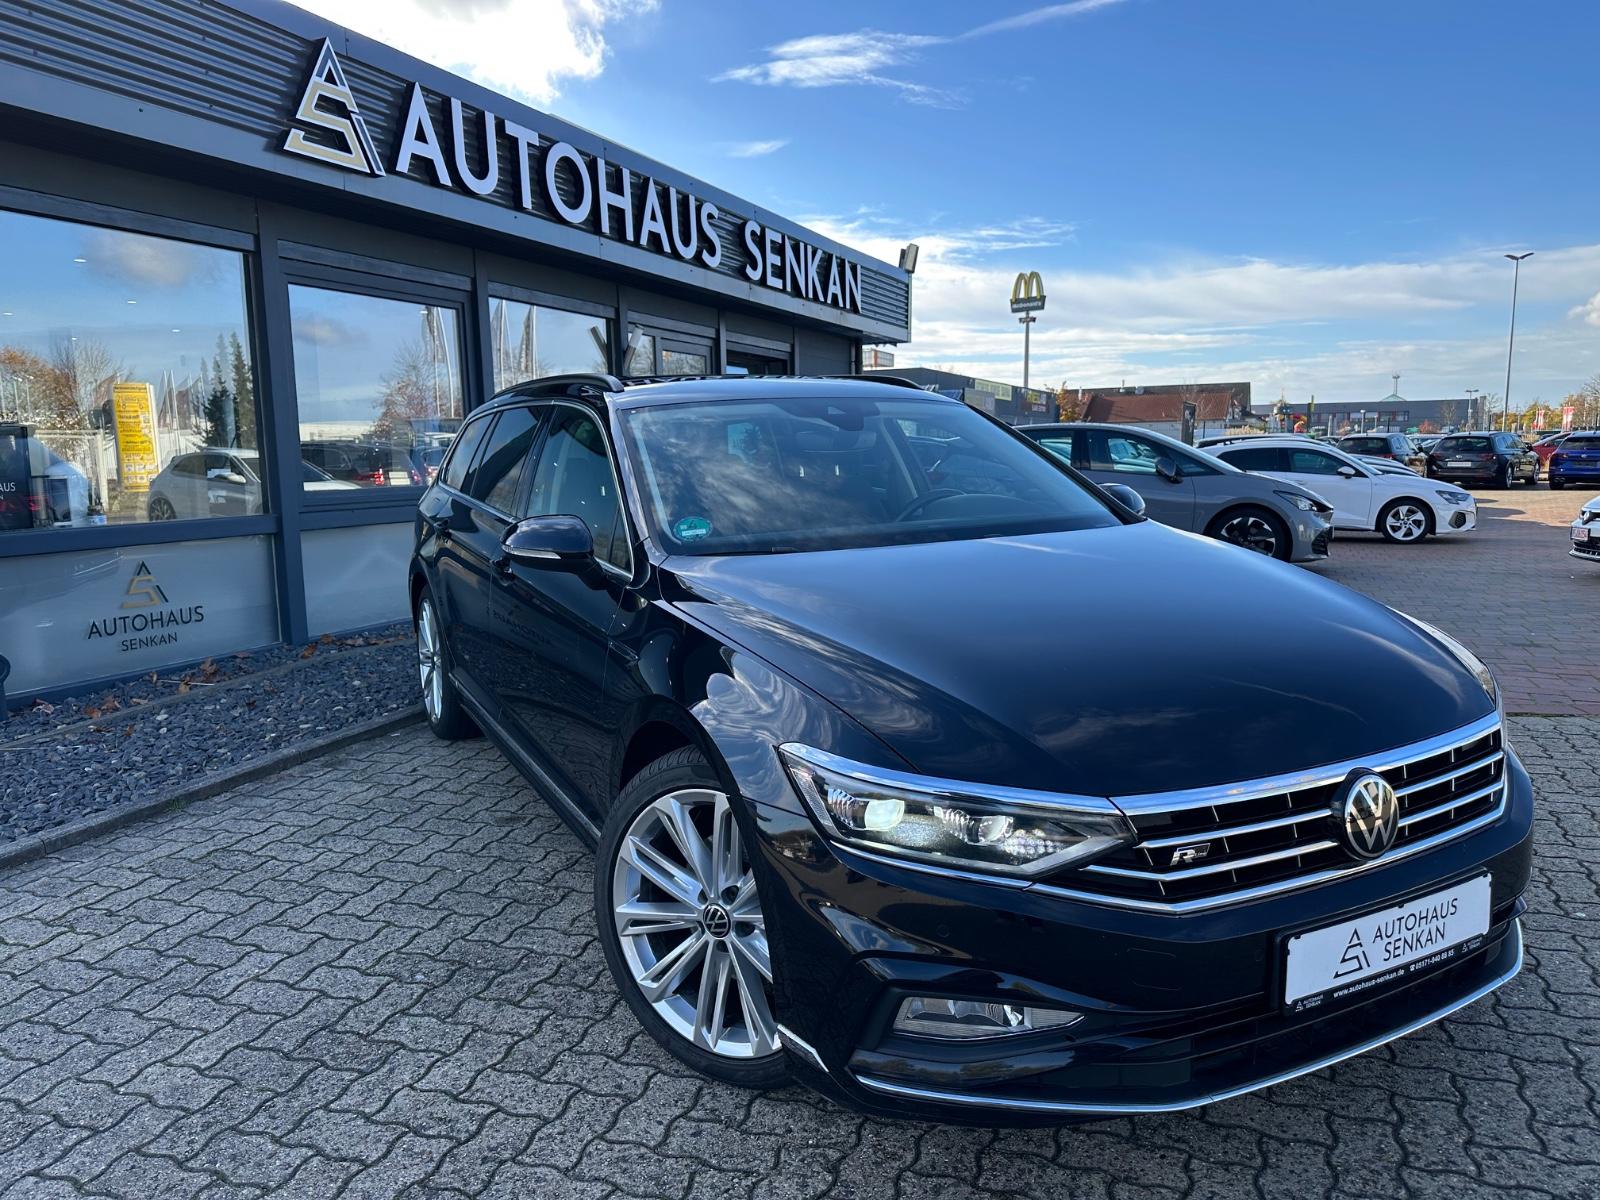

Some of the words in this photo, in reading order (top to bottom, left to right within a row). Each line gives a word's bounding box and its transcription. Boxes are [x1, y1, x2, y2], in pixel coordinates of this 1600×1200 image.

[396, 82, 722, 268] AUTOHAUS
[745, 220, 862, 314] SENKAN
[88, 605, 205, 639] AUTOHAUS
[121, 632, 178, 652] SENKAN
[1372, 898, 1458, 944] AUTOHAUS
[1383, 922, 1446, 962] SENKAN
[1333, 969, 1405, 998] www.autohaus-senkan.de
